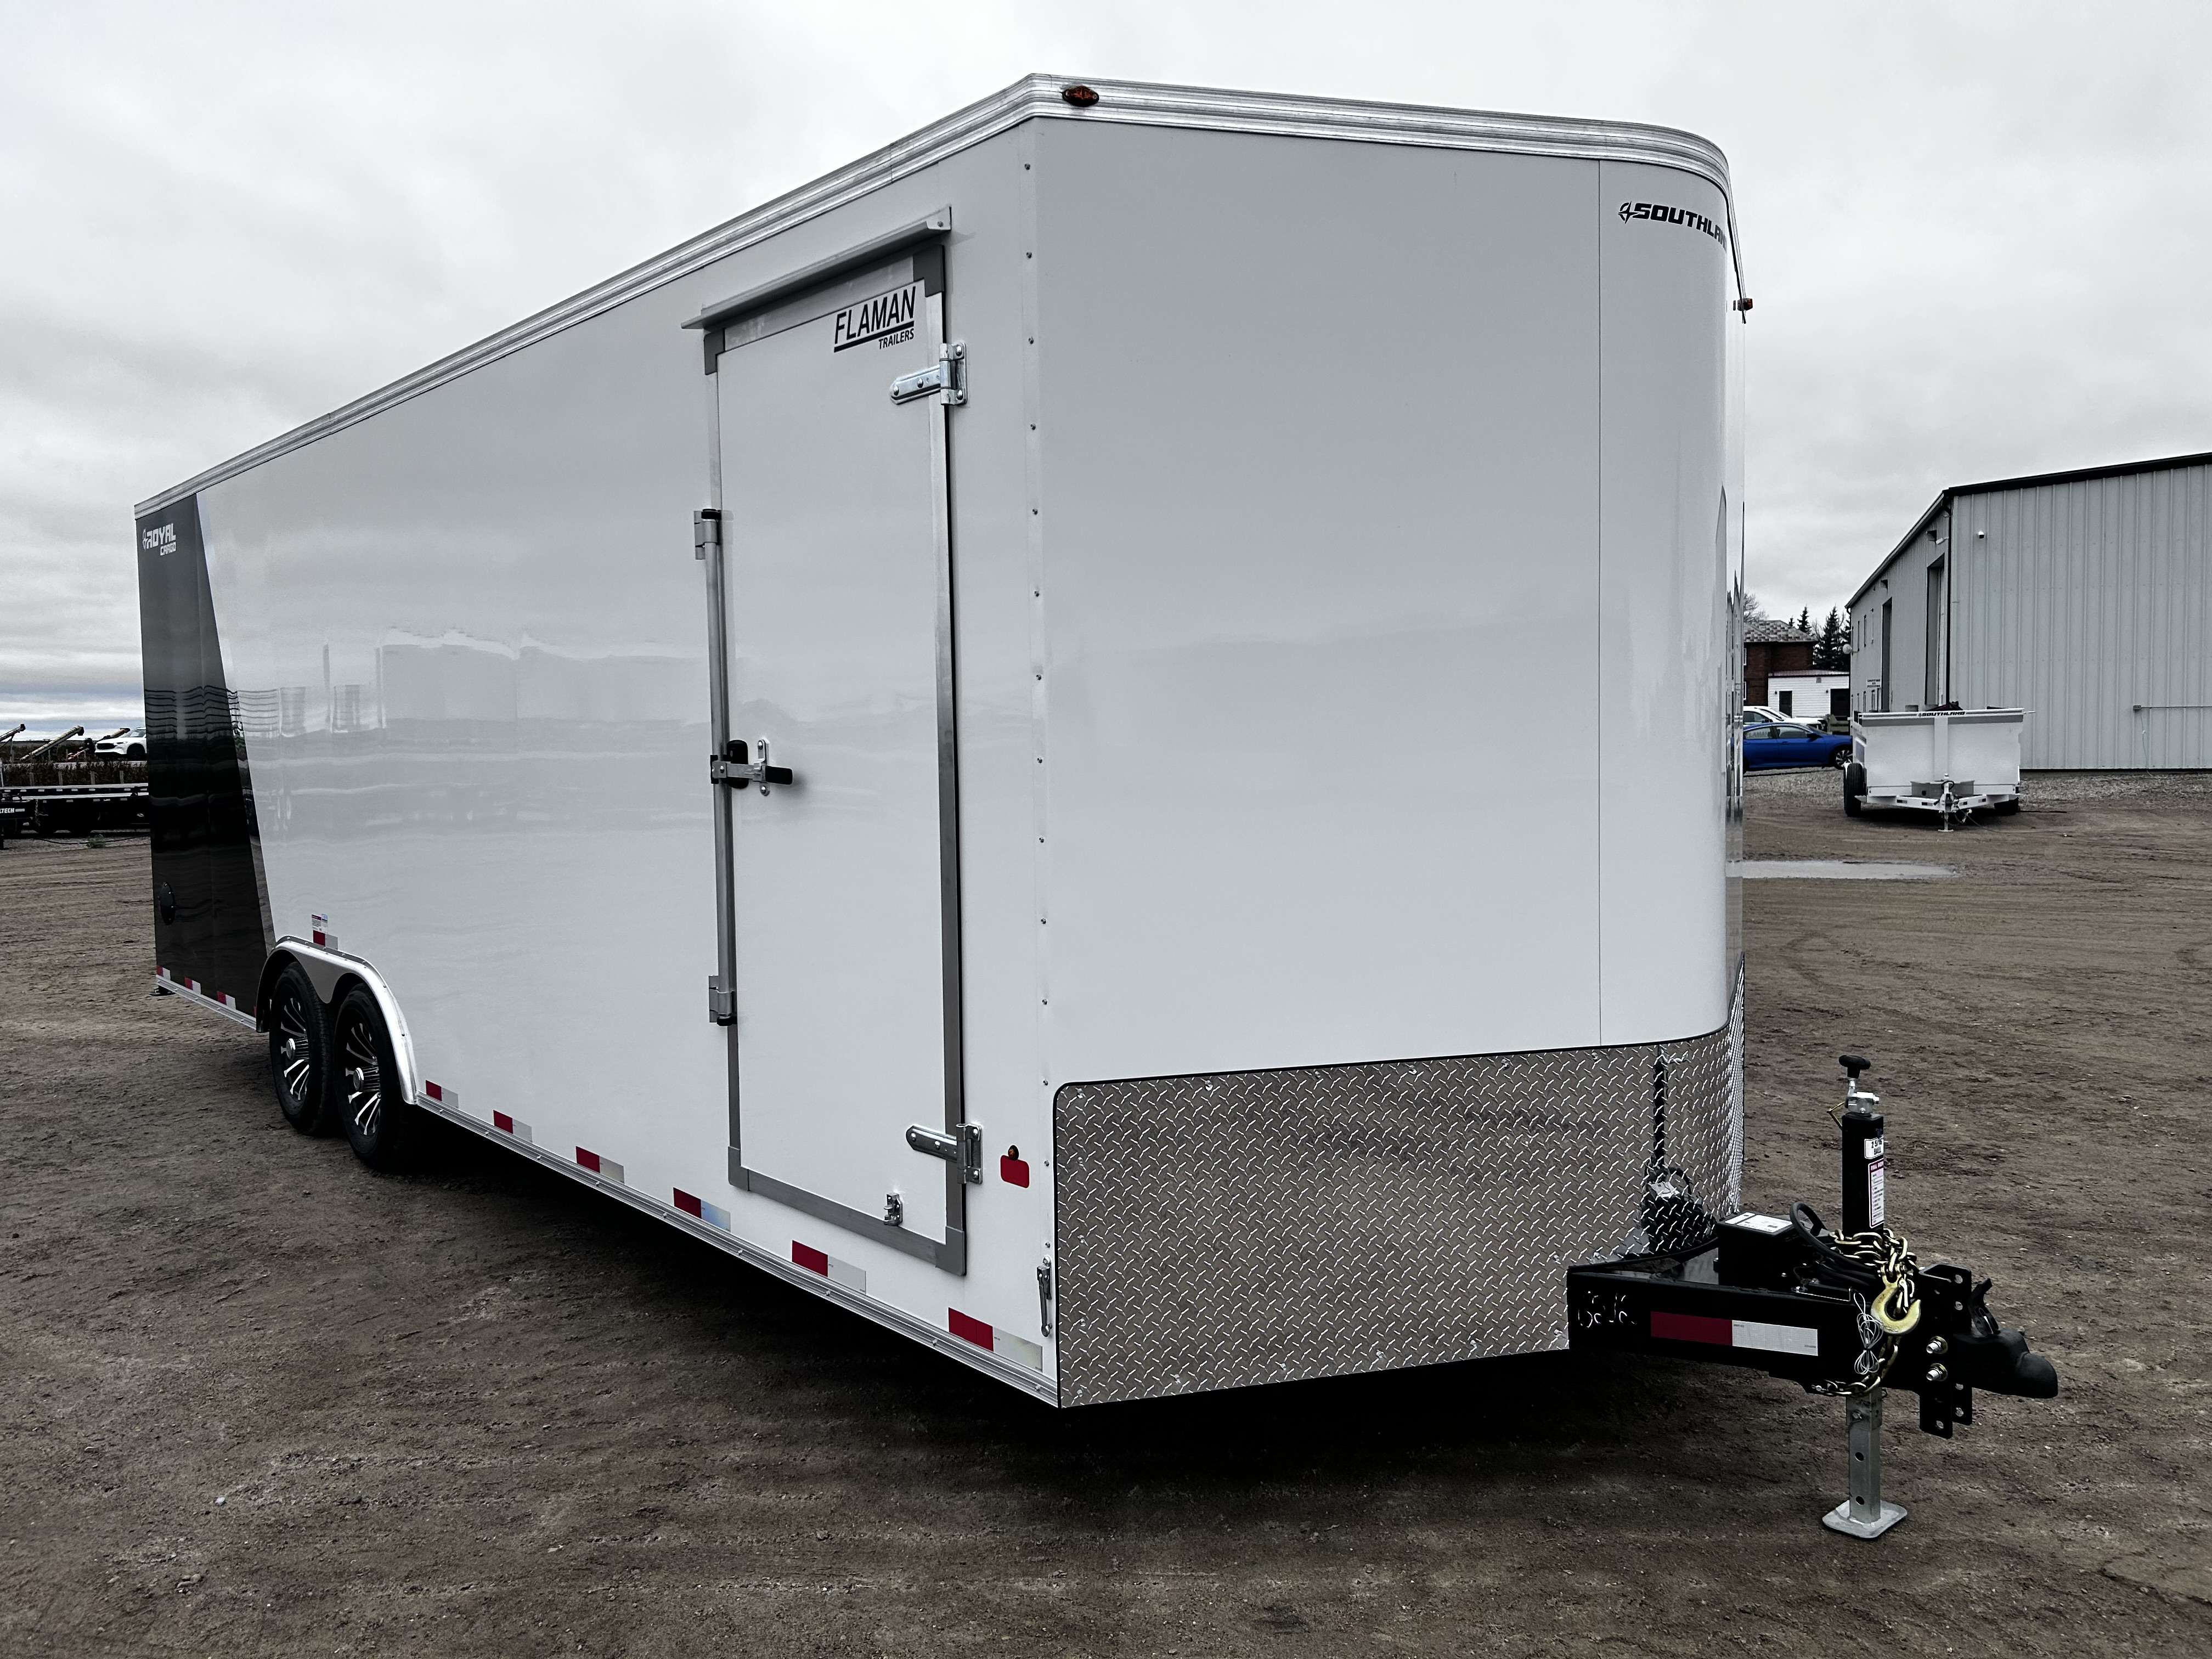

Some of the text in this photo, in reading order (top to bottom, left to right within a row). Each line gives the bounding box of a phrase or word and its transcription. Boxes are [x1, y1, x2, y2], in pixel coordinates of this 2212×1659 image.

[1632, 203, 1726, 252] SOUTHLAN
[834, 286, 916, 345] FLAMAN
[878, 328, 915, 349] TRAILERS
[146, 523, 176, 549] ROYAL
